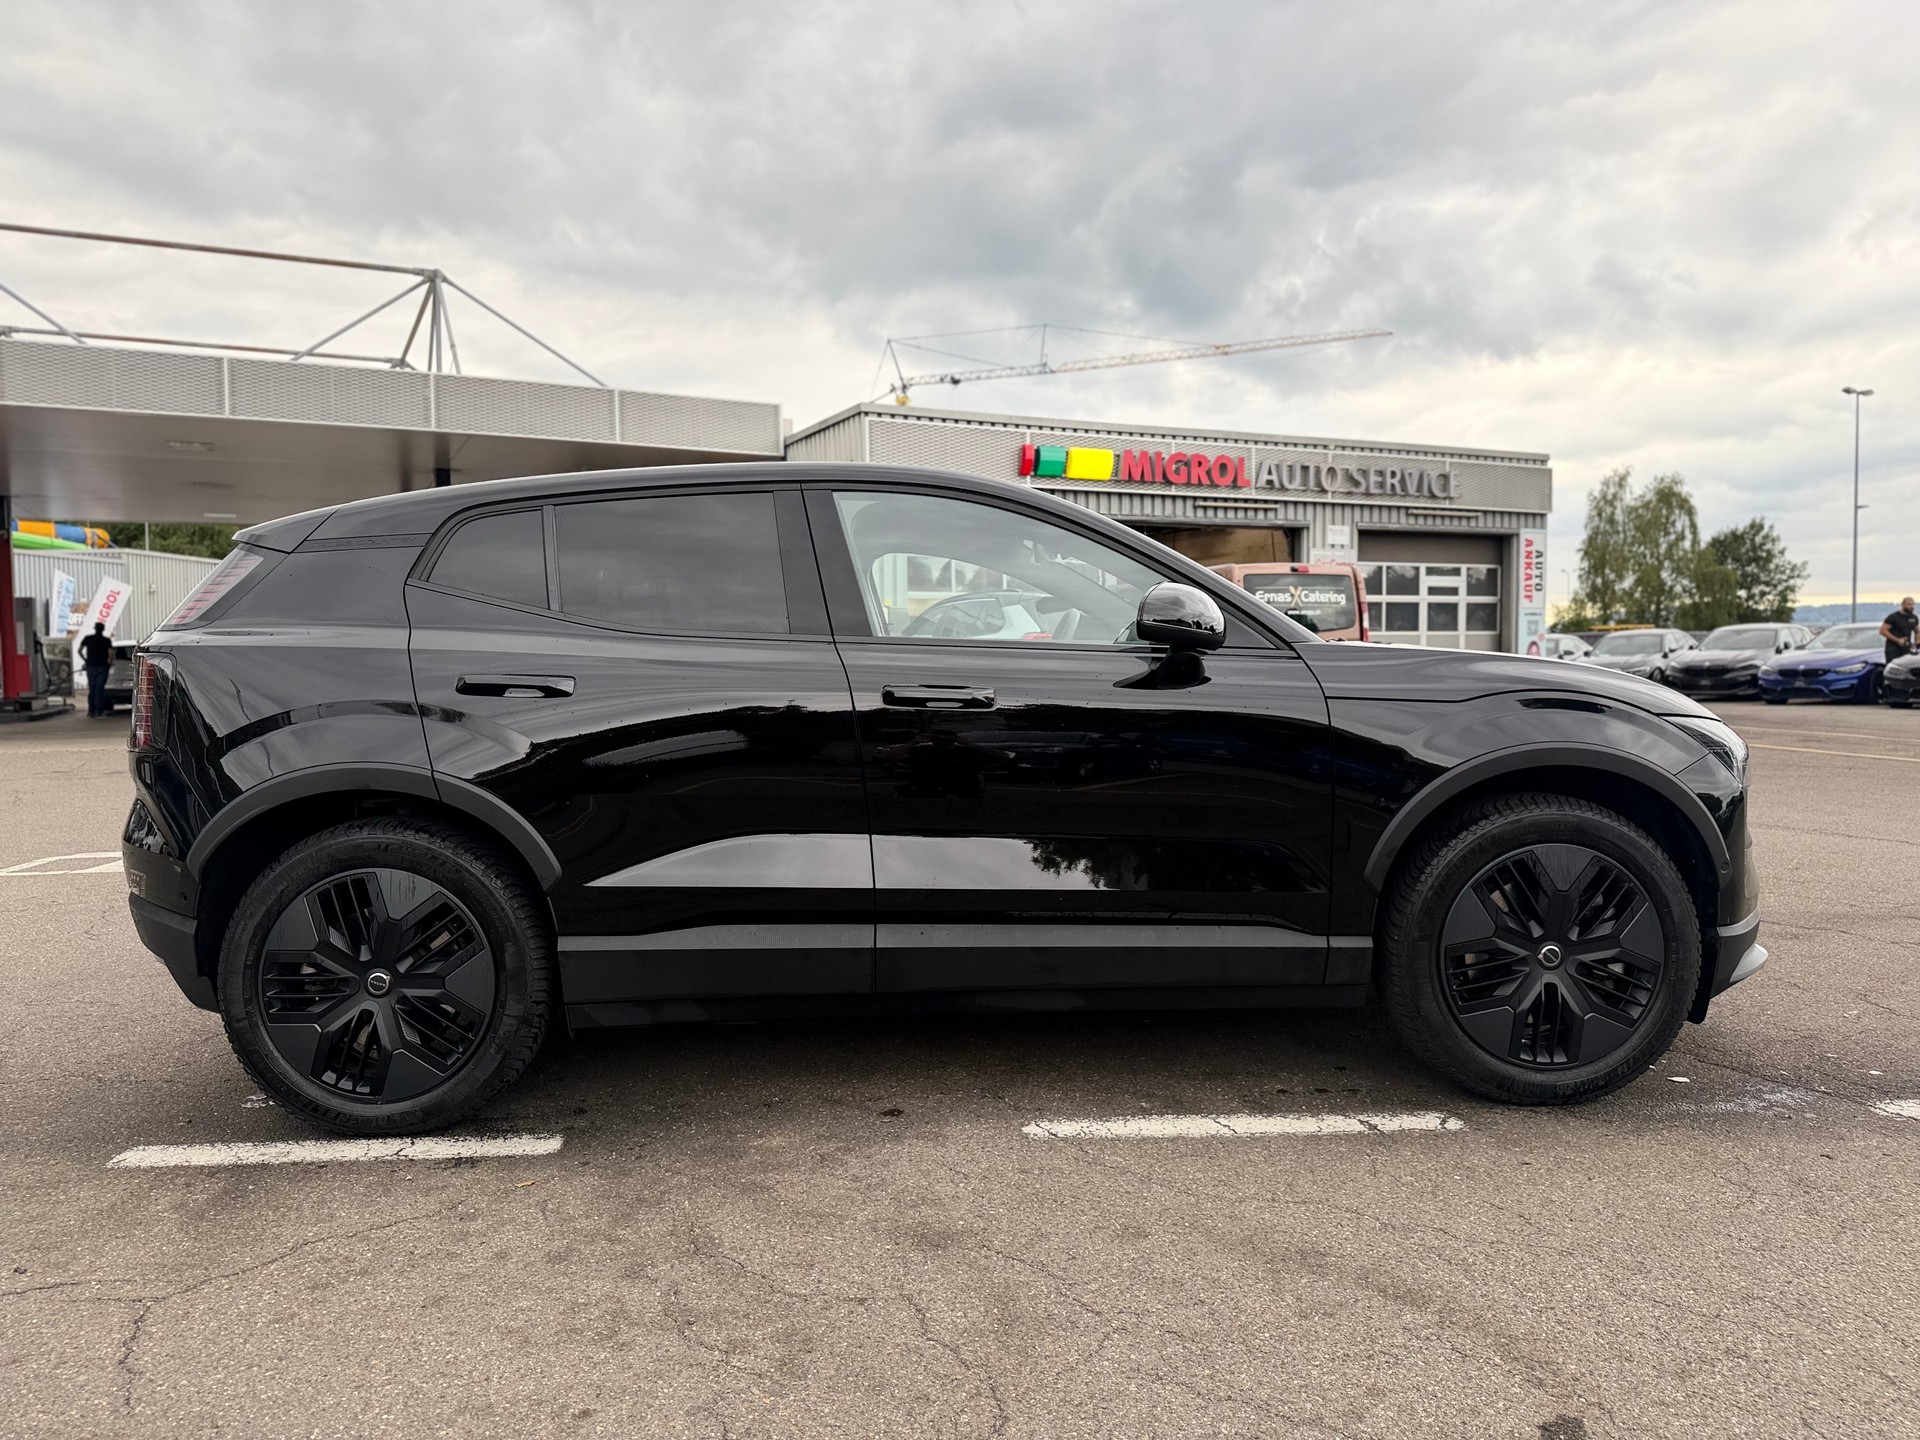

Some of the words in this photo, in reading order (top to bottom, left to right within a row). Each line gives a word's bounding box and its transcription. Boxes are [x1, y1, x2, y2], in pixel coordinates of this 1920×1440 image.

[1120, 449, 1251, 488] MIGROL
[1256, 459, 1341, 492] AUTO
[1350, 464, 1462, 499] SERVICE
[1524, 538, 1534, 603] ANKAUF
[1534, 550, 1543, 592] AUTO
[95, 589, 121, 627] IGROL
[1255, 590, 1292, 602] Ernas
[1301, 590, 1346, 605] Catering
